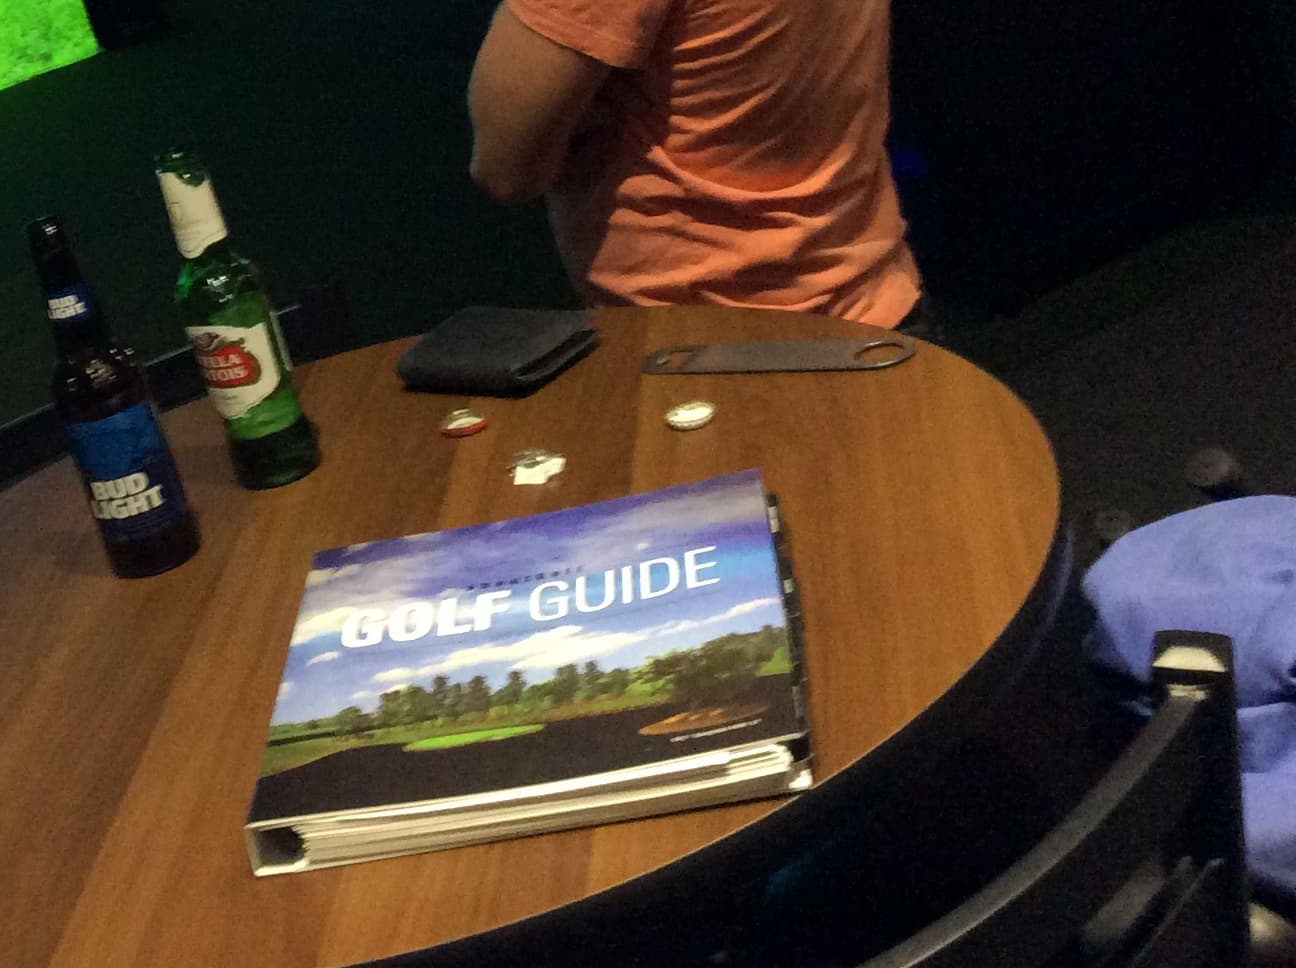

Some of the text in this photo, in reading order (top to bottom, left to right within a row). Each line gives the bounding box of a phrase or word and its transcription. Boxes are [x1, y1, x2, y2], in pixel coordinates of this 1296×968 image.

[207, 364, 249, 382] TOIS
[90, 472, 150, 501] BUD
[91, 483, 166, 520] LIGHT
[340, 545, 722, 649] GOLF GUIDE
